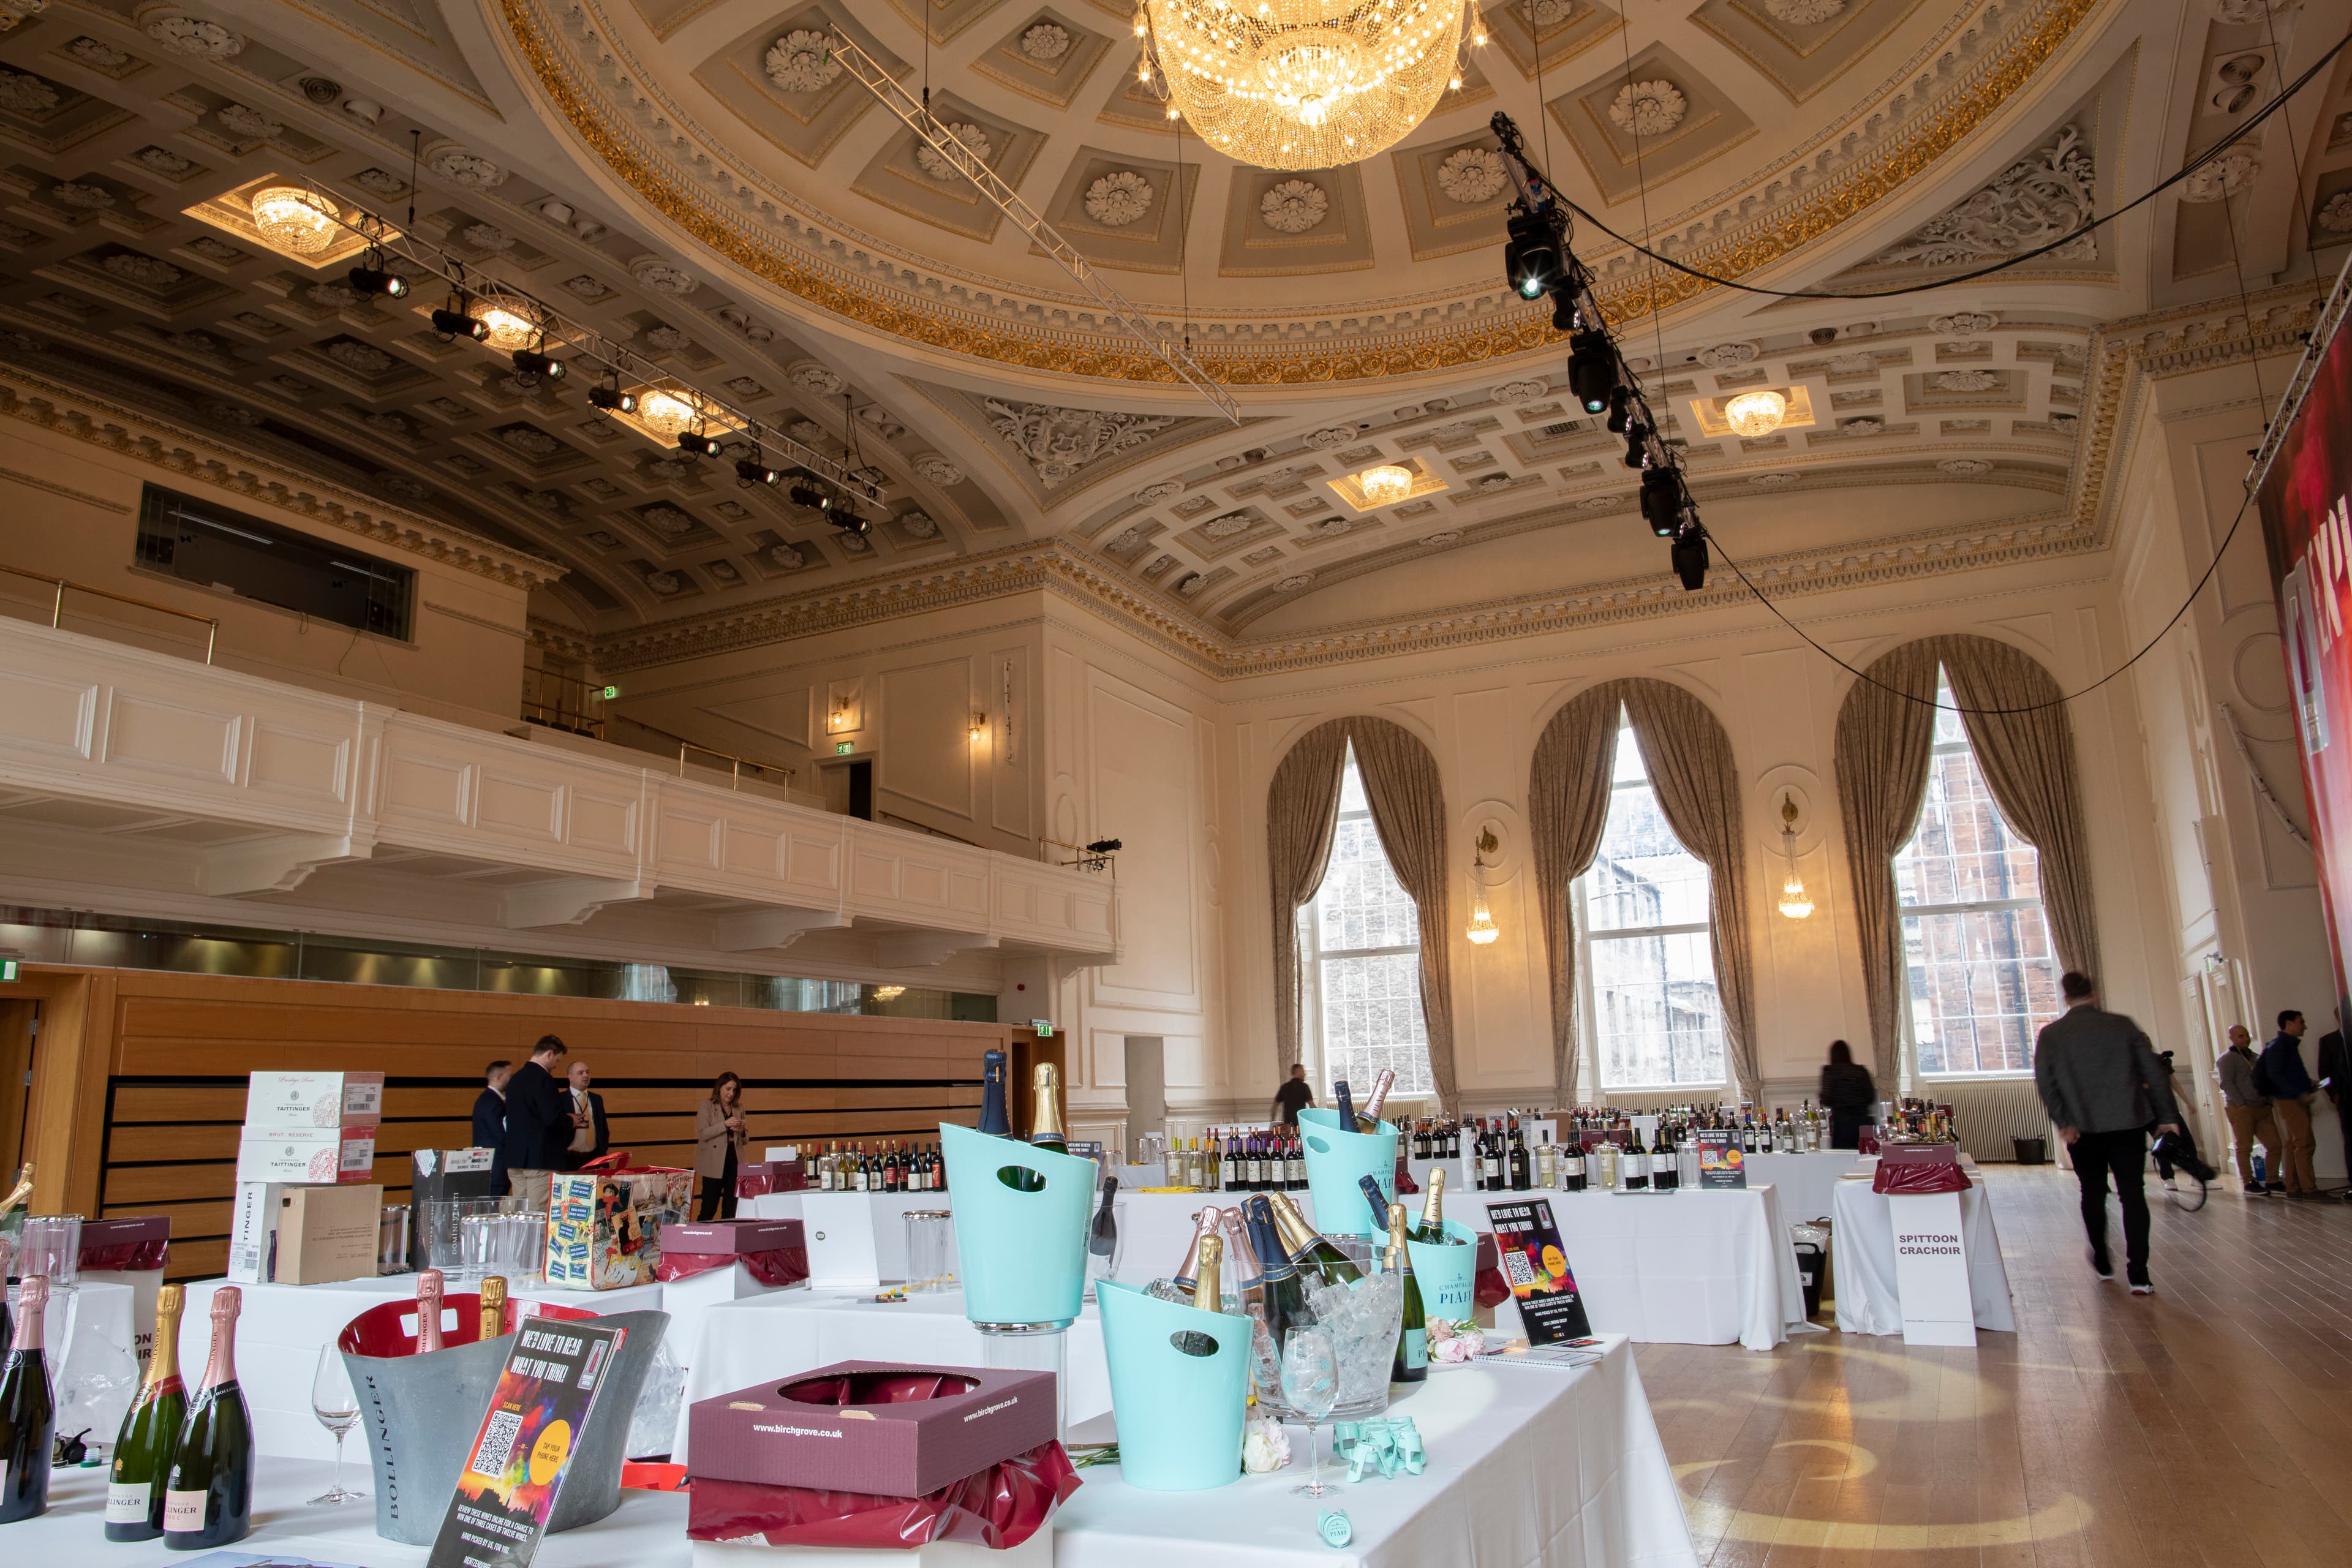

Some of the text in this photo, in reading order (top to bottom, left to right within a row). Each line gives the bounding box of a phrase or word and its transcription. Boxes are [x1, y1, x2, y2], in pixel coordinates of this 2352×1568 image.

[1490, 1207, 1532, 1220] WE'D LOVE TO HEAR
[1494, 1223, 1509, 1234] WHAT
[1507, 1222, 1519, 1232] YOU
[1517, 1221, 1534, 1231] THINK!
[149, 1327, 161, 1371] BOLLINGER
[206, 1332, 218, 1378] BOLLINGER
[521, 1330, 582, 1357] WE'D LOVE TO HEAR
[510, 1355, 535, 1376] WHAT
[530, 1359, 548, 1379] YOU
[543, 1362, 570, 1383] THINK!
[503, 1401, 513, 1411] SCAN
[964, 1396, 1018, 1423] www.birchgrove.co.uk
[753, 1423, 843, 1438] www.birchgrove.co.uk
[366, 1376, 399, 1519] BOLLINGER
[537, 1452, 559, 1463] PHONE HERE
[550, 1444, 561, 1452] YOUR
[458, 1504, 471, 1515] REVIEW
[470, 1507, 481, 1518] THESE
[480, 1511, 492, 1521] WINES
[491, 1514, 505, 1525] ONLINE
[503, 1518, 512, 1528] FOR
[513, 1521, 529, 1533] CHANCE
[528, 1526, 534, 1535] TO
[470, 1517, 477, 1525] OF
[475, 1518, 486, 1529] THREE
[486, 1522, 497, 1532] CASES
[497, 1525, 503, 1534] OF
[501, 1527, 516, 1539] TWELVE
[514, 1531, 529, 1542] WINES.
[461, 1532, 472, 1542] HAND
[470, 1534, 484, 1545] PICKED
[483, 1539, 490, 1547] BY
[493, 1542, 502, 1552] FOR
[500, 1545, 510, 1555] YOU.
